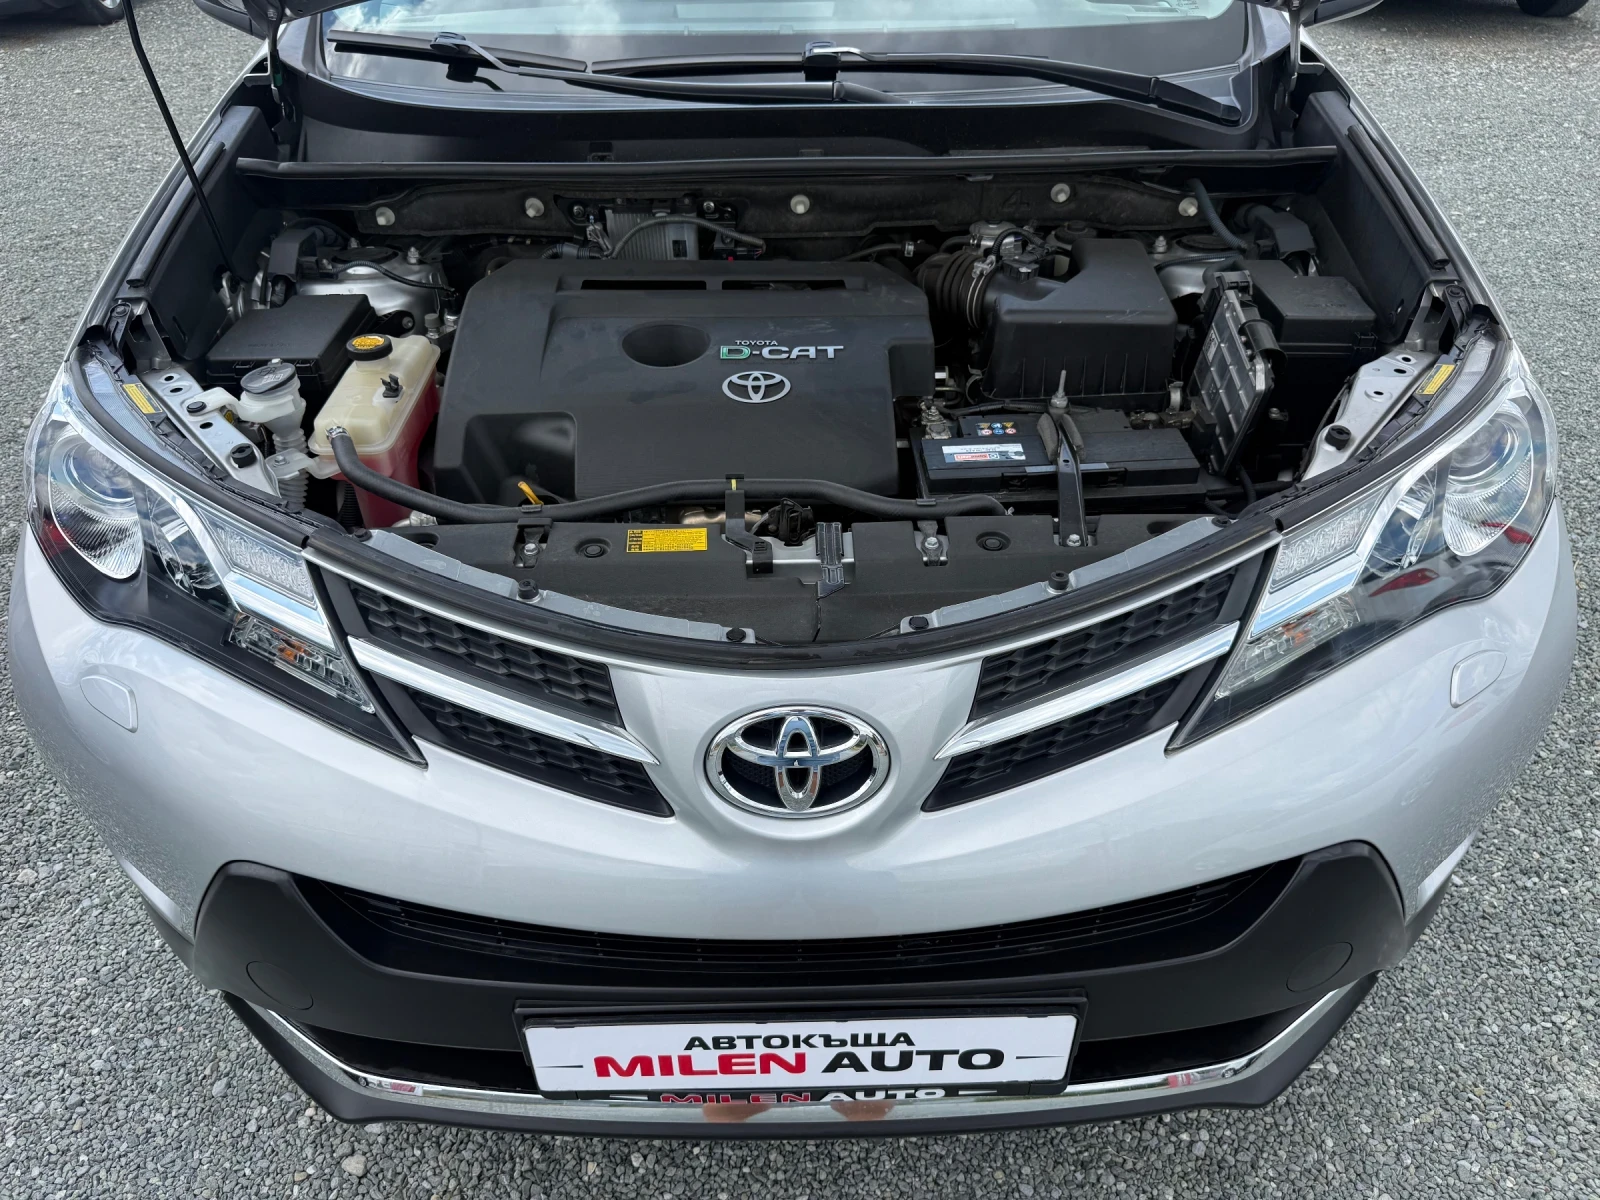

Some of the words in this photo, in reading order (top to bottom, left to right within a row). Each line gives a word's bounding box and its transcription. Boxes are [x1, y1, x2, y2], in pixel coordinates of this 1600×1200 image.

[720, 345, 844, 359] D-CAT
[684, 1032, 916, 1051] АВТОКЪША
[594, 1052, 806, 1077] MILEN
[821, 1048, 1005, 1073] AUTO
[660, 1092, 811, 1104] MILEN
[820, 1088, 946, 1102] AUTO
